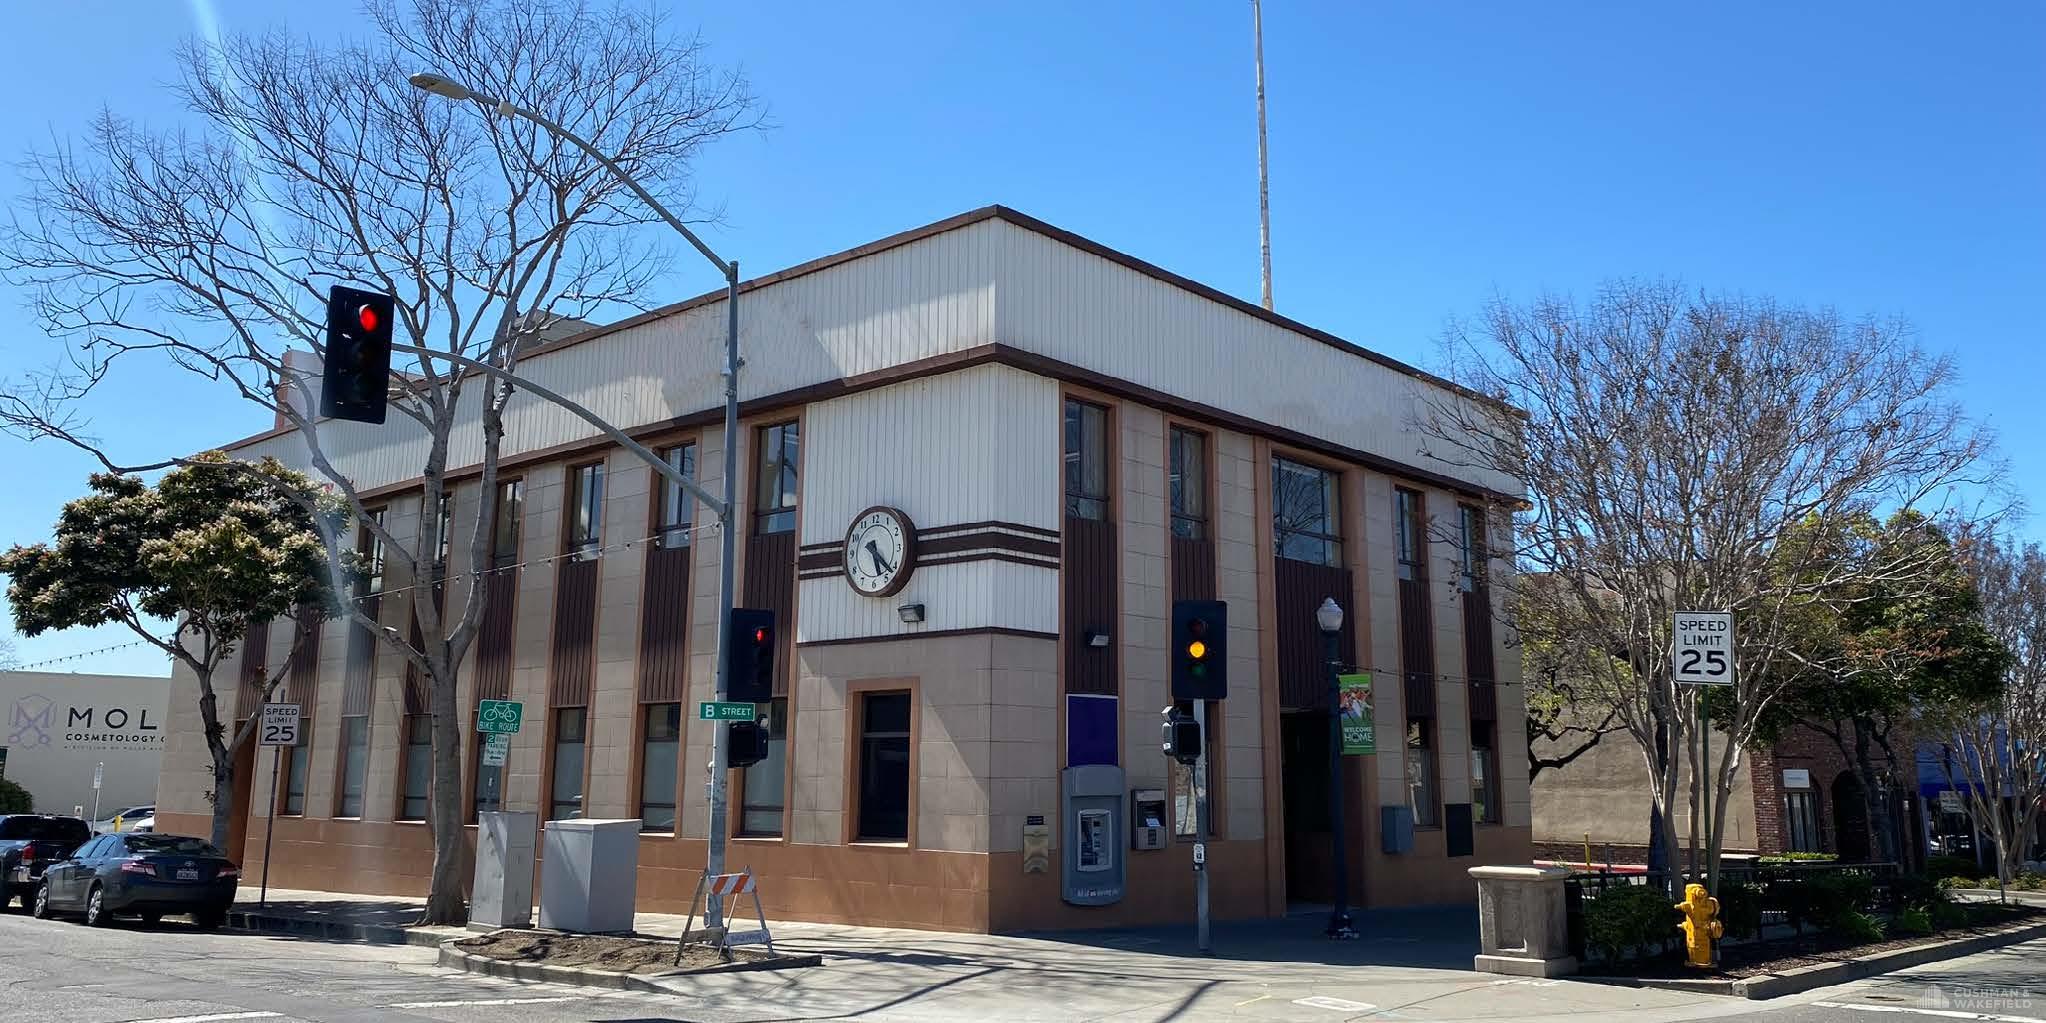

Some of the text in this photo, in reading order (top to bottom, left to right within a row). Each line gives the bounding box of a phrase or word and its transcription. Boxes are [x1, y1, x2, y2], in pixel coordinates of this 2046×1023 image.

[872, 514, 880, 524] 12
[886, 517, 889, 525] 1
[860, 521, 867, 529] 11
[894, 527, 899, 537] 2
[852, 533, 860, 543] 10
[896, 543, 902, 553] 3
[849, 549, 855, 559] 9
[892, 560, 898, 570] 4
[852, 566, 857, 575] 8
[860, 577, 865, 586] 7
[884, 573, 889, 583] 5
[871, 579, 877, 589] 6
[1679, 620, 1727, 632] SPEED
[1683, 634, 1723, 646] LIMIT
[1680, 649, 1727, 676] 25
[265, 708, 298, 716] SPEED
[705, 704, 751, 718] B STREET
[67, 707, 158, 730] MOL
[479, 721, 519, 732] BIKE ROUTE
[65, 733, 156, 743] COSMETOLOGY
[264, 725, 295, 742] 25
